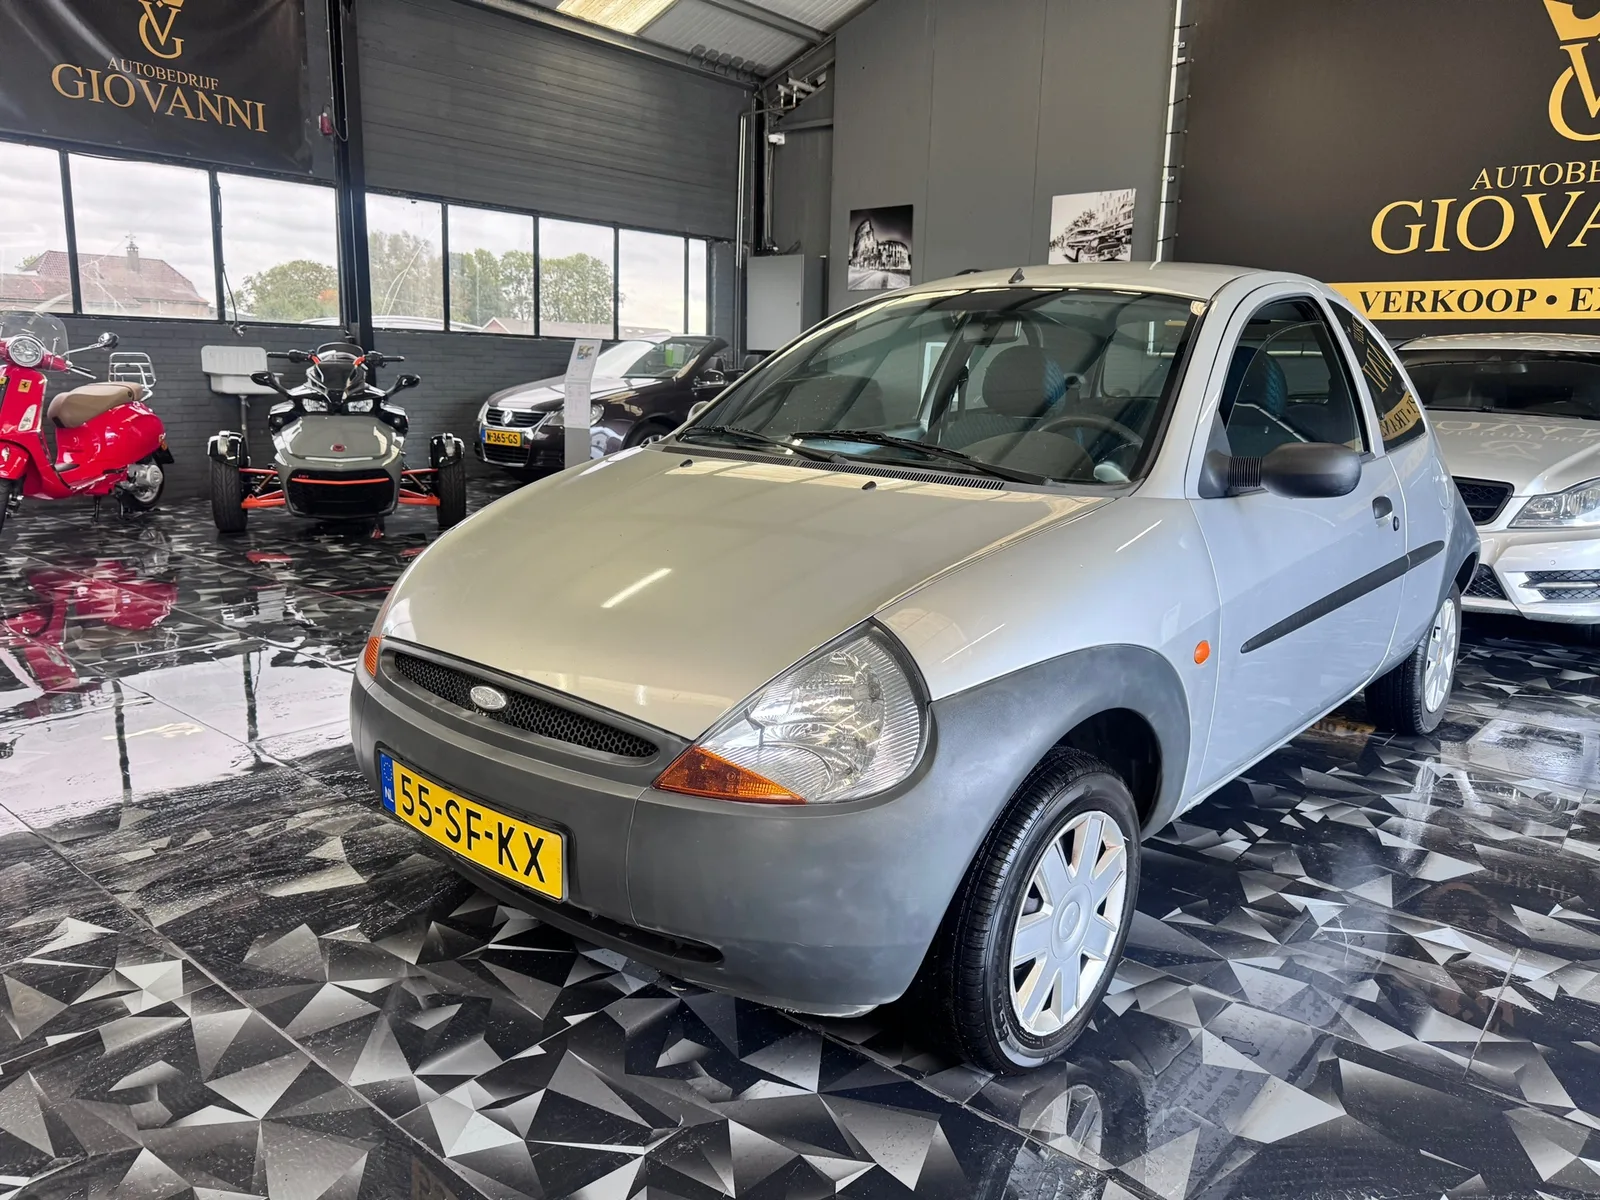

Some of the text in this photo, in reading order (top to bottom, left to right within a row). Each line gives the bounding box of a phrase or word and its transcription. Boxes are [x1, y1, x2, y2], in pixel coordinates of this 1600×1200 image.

[107, 57, 219, 90] AUTOBEDRIJF
[51, 63, 268, 132] GIOVANNI
[1359, 286, 1600, 313] VERKOOP E
[384, 785, 394, 803] NL
[401, 773, 546, 884] 55-SF-KX
